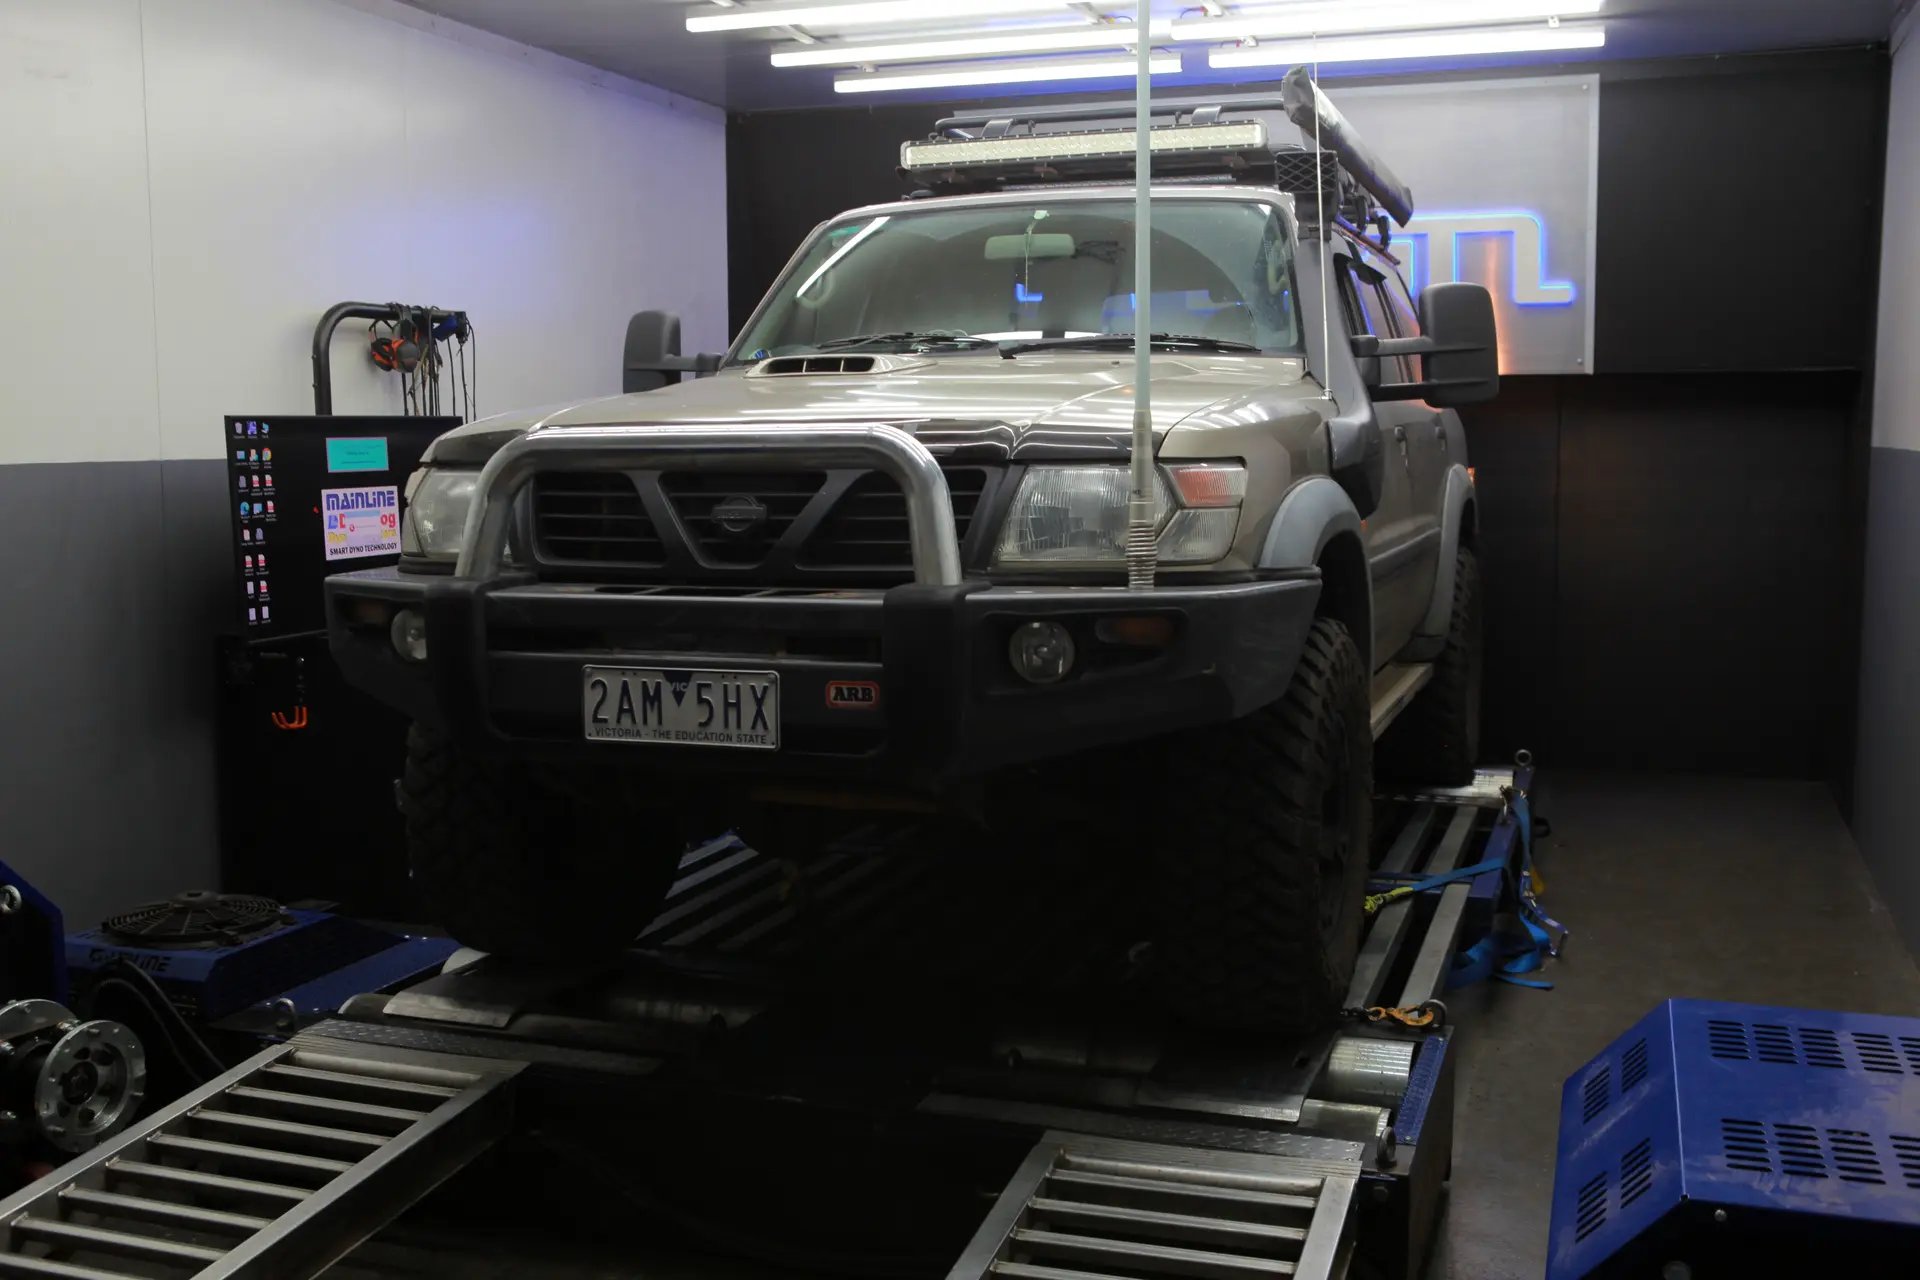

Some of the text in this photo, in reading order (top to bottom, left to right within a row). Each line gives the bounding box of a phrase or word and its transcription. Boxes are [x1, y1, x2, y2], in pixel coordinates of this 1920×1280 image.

[330, 542, 397, 555] SMART DYNO TECHNOLOGY
[832, 686, 873, 702] ARB
[590, 677, 769, 731] 2AM 5HX
[595, 728, 642, 738] VICTORIA
[653, 730, 671, 740] THE
[675, 731, 733, 743] EDUCATION
[736, 734, 767, 744] STATE
